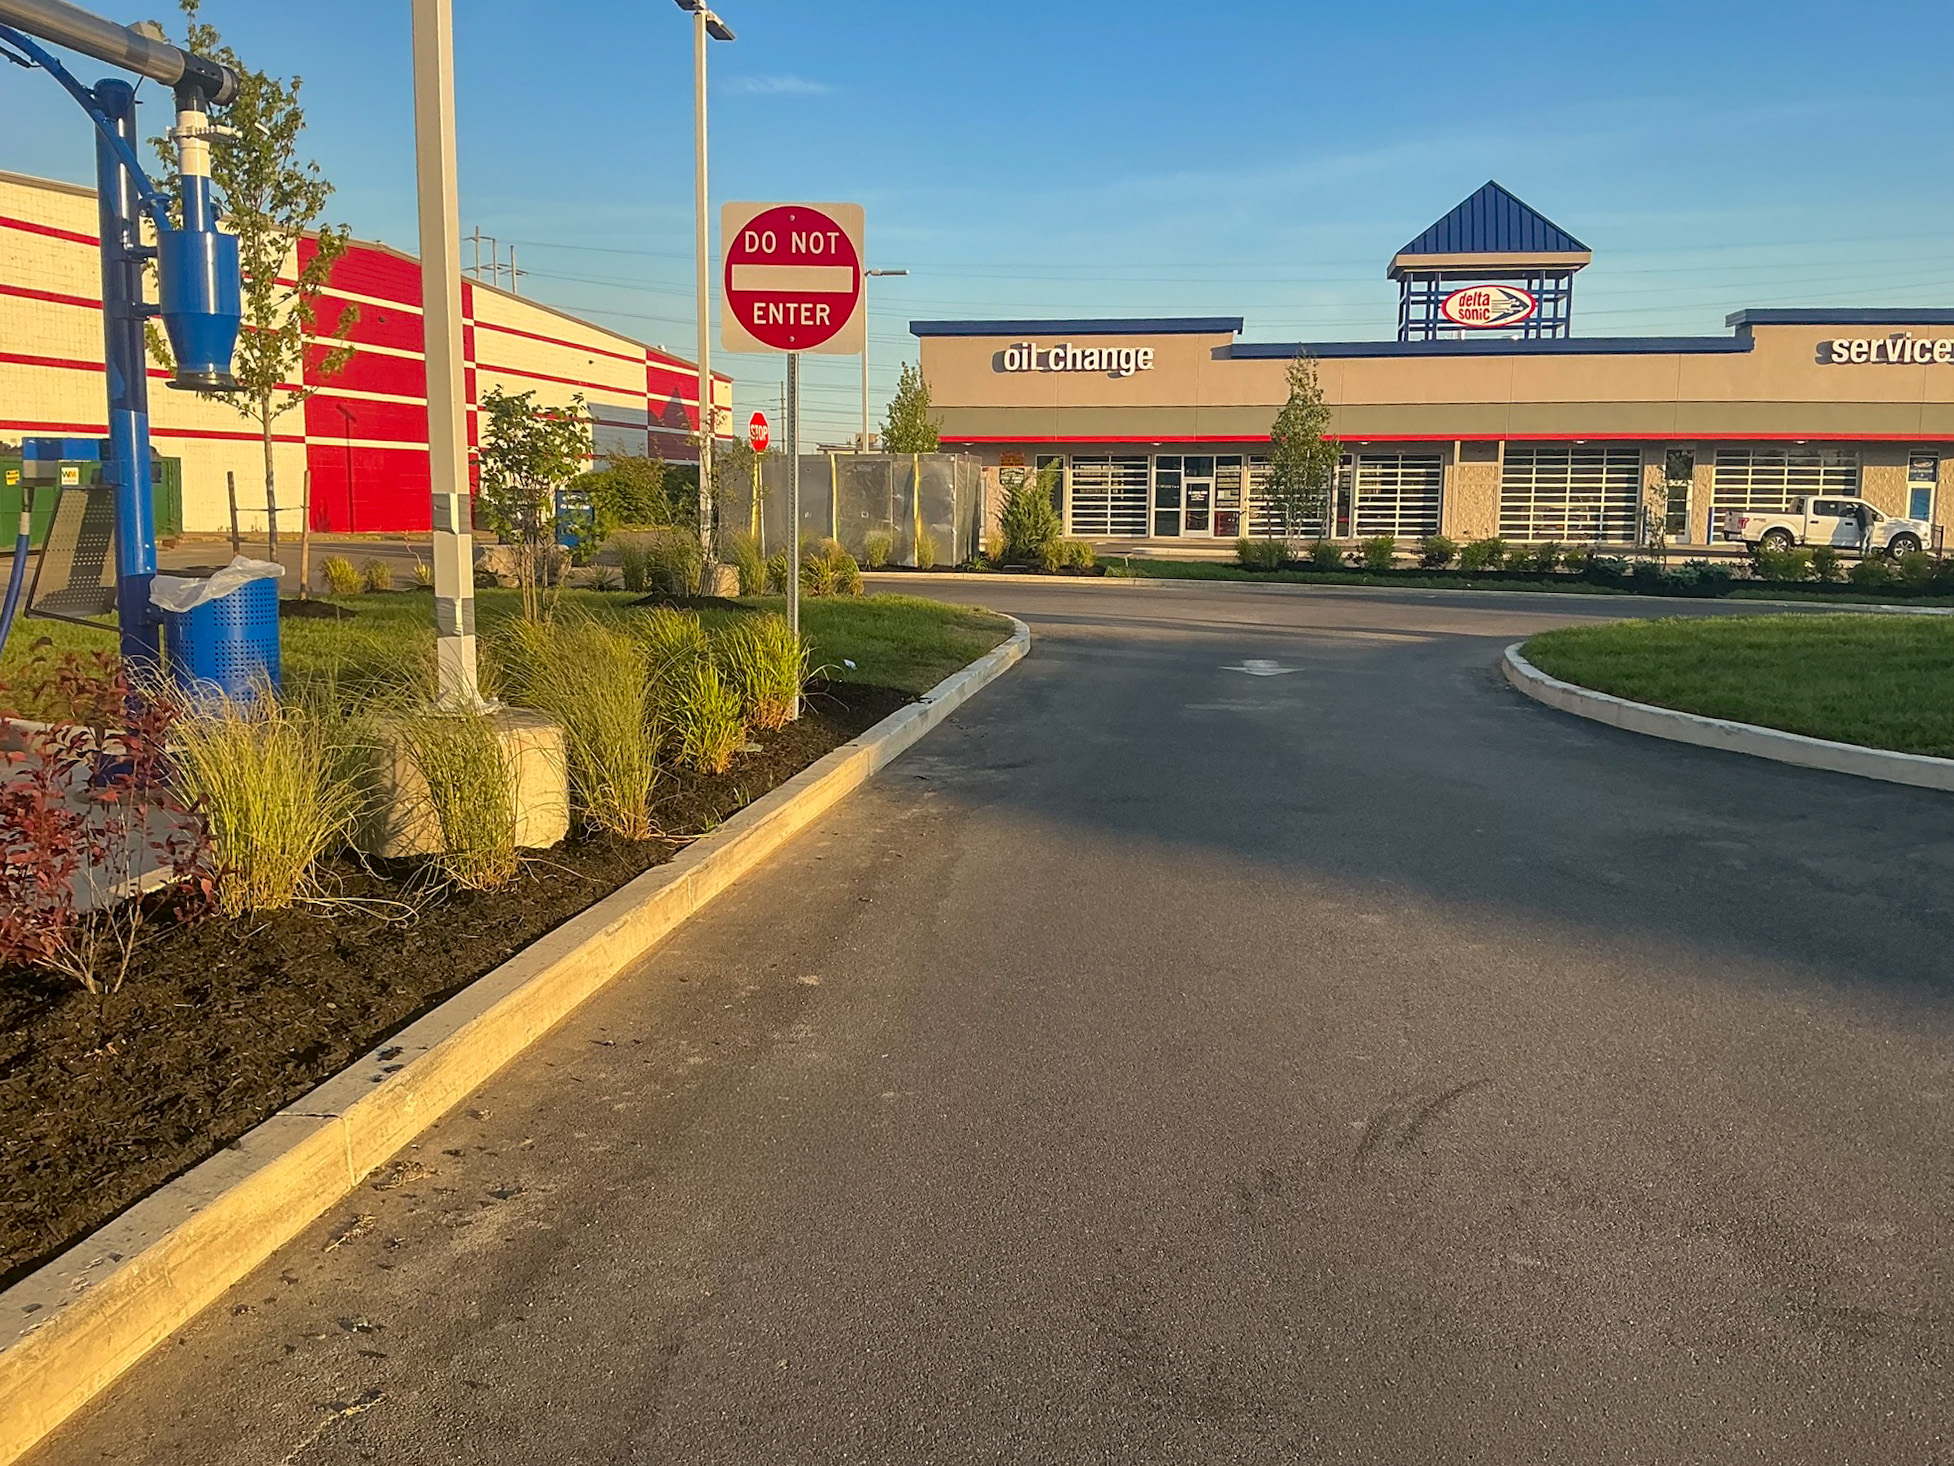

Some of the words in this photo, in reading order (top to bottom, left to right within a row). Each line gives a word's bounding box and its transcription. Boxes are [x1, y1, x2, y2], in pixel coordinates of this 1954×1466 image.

[744, 230, 777, 254] DO
[791, 231, 840, 255] NOT
[1458, 291, 1491, 307] delta
[753, 302, 831, 326] ENTER
[1458, 308, 1491, 320] sonic
[1831, 331, 1953, 363] service
[1003, 342, 1038, 371] oil
[1048, 342, 1155, 377] change
[750, 424, 768, 441] STOP
